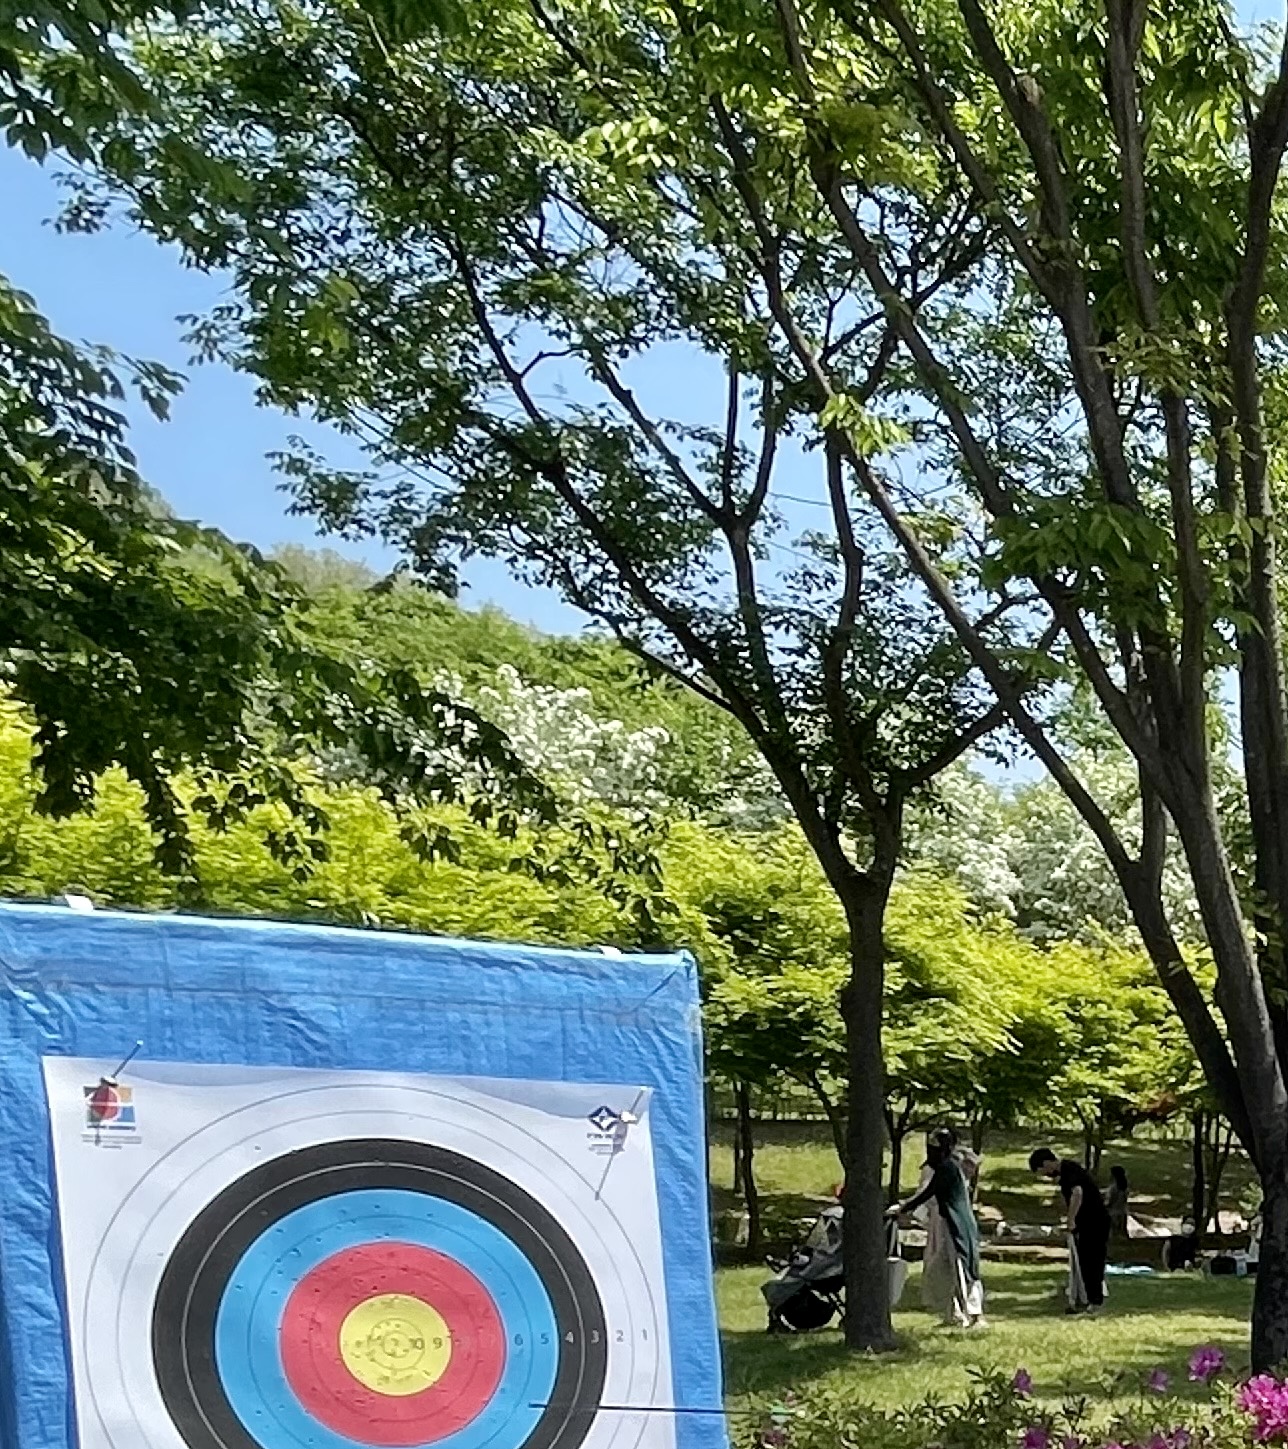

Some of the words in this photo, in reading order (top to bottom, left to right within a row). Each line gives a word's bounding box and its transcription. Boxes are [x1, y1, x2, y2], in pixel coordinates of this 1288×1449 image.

[431, 1335, 443, 1350] 9
[514, 1333, 525, 1347] 6
[540, 1333, 550, 1346] 5
[564, 1331, 575, 1344] 4
[590, 1330, 601, 1344] 3
[615, 1329, 625, 1343] 2
[640, 1328, 649, 1341] 1
